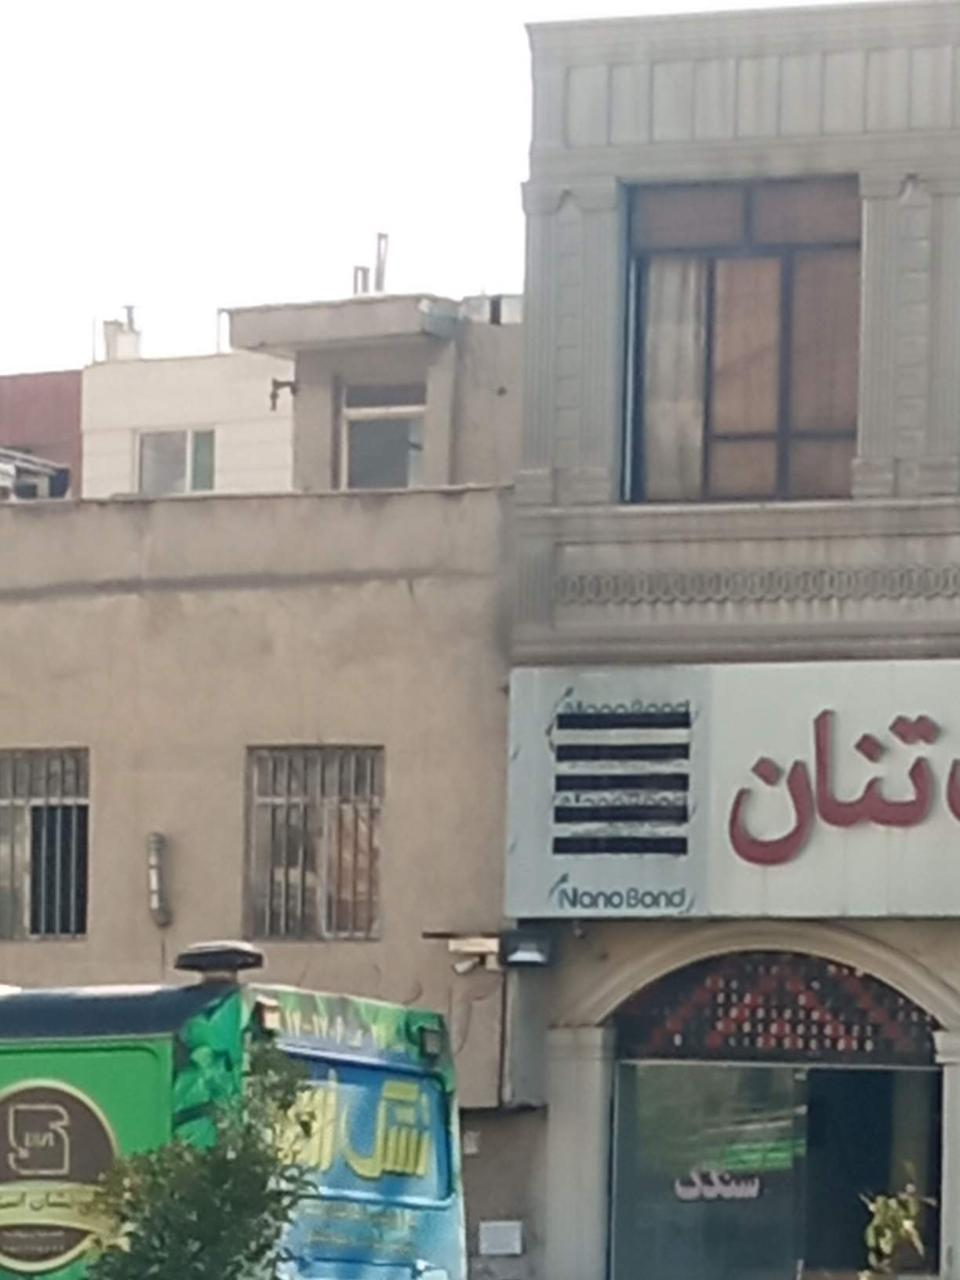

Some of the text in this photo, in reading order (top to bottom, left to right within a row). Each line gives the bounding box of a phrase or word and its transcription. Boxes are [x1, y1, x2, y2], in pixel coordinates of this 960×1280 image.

[728, 709, 942, 866] تنان
[558, 886, 685, 909] NanoBond
[674, 1166, 760, 1201] سنگک
